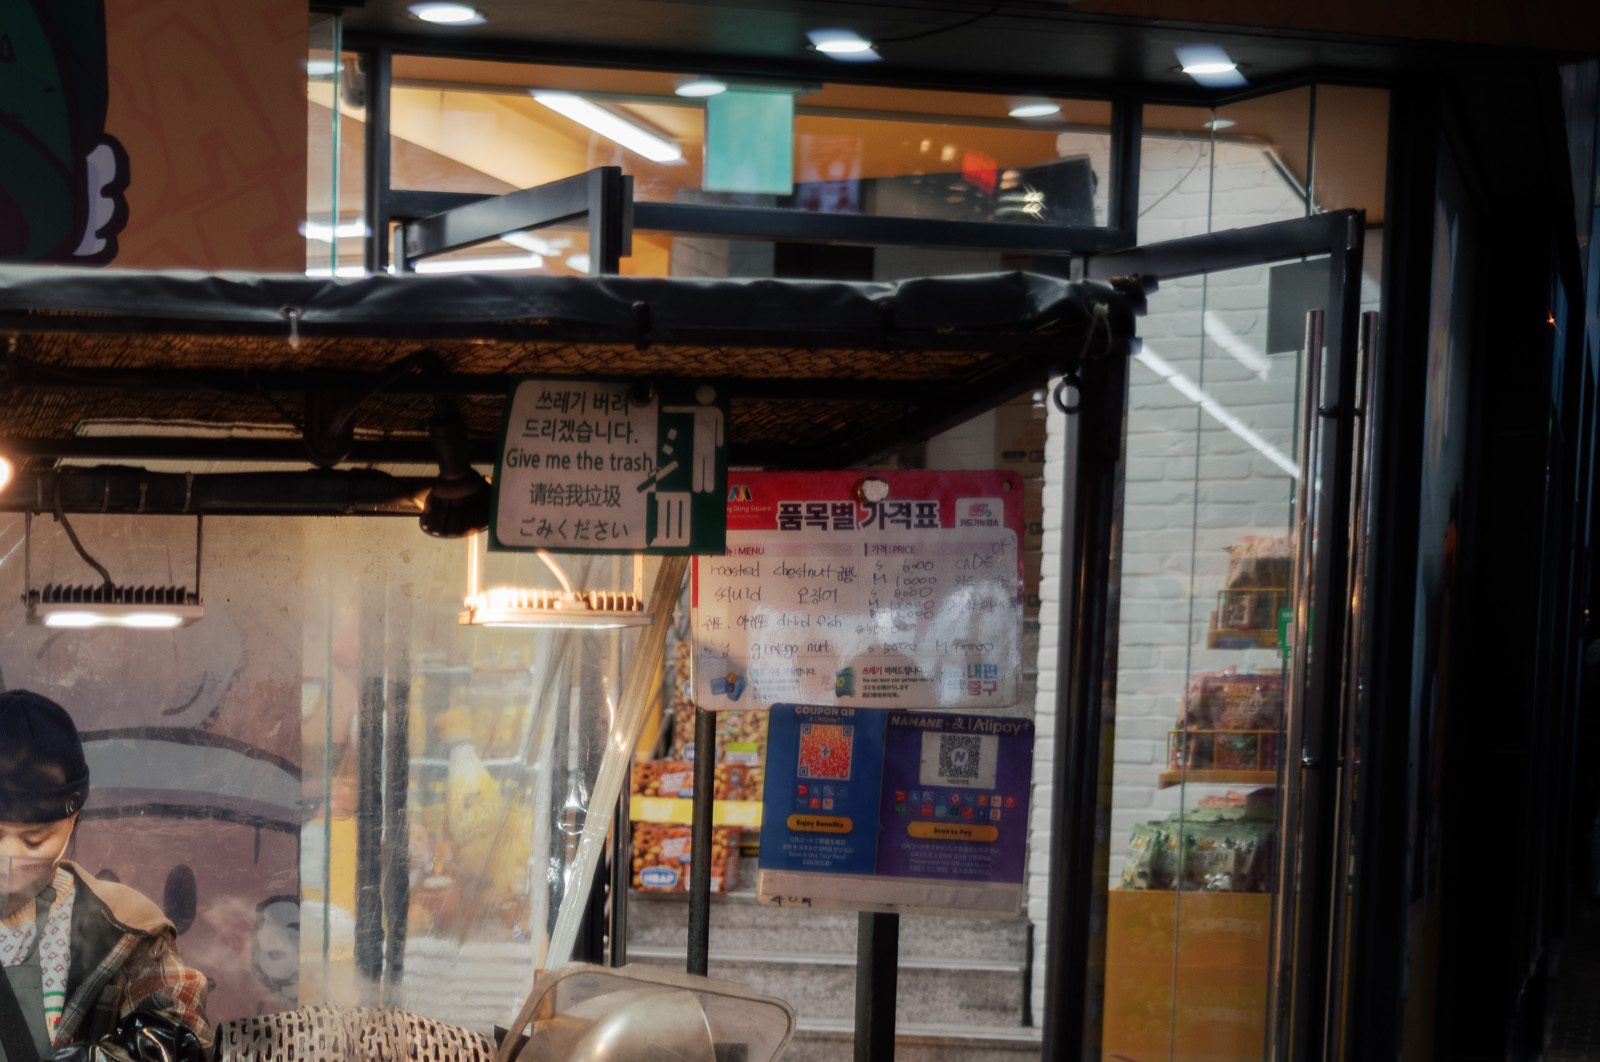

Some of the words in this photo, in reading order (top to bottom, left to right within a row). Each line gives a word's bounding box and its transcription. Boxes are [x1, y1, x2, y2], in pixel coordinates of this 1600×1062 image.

[535, 391, 586, 415] 쓰레기
[593, 392, 630, 417] 버려
[522, 419, 639, 445] 드리겠습니다.
[506, 449, 540, 469] Give
[545, 453, 570, 471] me
[576, 451, 603, 471] the
[610, 452, 653, 473] trash
[530, 483, 621, 508] 请给我垃圾
[778, 502, 855, 530] 품목별
[861, 503, 939, 529] 가격표
[520, 517, 628, 541] ごみください
[738, 547, 765, 556] MENU
[872, 545, 887, 555] 가격
[893, 545, 915, 554] PRICE
[710, 561, 760, 578] roasted
[773, 561, 834, 579] chestnut
[873, 572, 887, 585] M
[797, 587, 837, 605] 오징어
[816, 614, 842, 629] fish
[807, 640, 830, 653] nut
[862, 666, 883, 675] 쓰레기
[968, 664, 998, 679] 내편
[795, 706, 838, 716] COUPON
[841, 708, 855, 717] QR
[891, 716, 943, 728] NAMANE
[796, 818, 814, 829] Enjoy
[815, 819, 844, 829] Benefits
[933, 827, 950, 835] Scan
[951, 828, 958, 836] to
[959, 828, 973, 837] Pay
